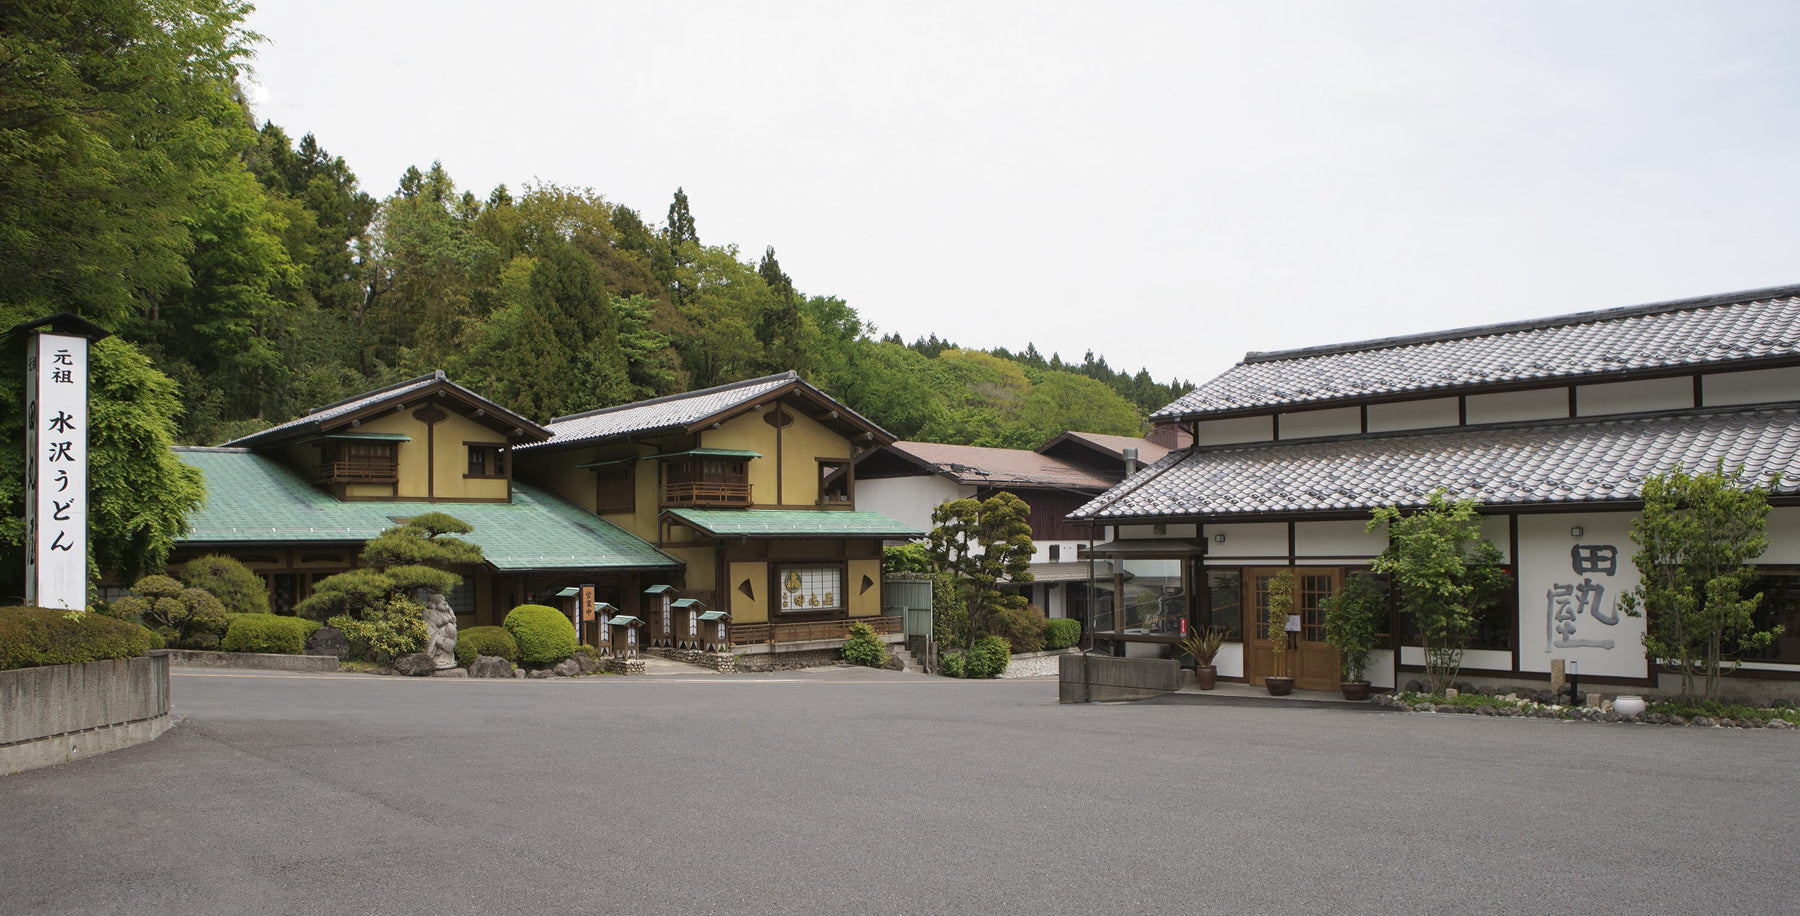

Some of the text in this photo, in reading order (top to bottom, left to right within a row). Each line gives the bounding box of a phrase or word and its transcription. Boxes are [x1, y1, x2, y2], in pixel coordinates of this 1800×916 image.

[48, 349, 77, 552] 元祖 水沢うどん
[1544, 543, 1620, 654] 田丸屋
